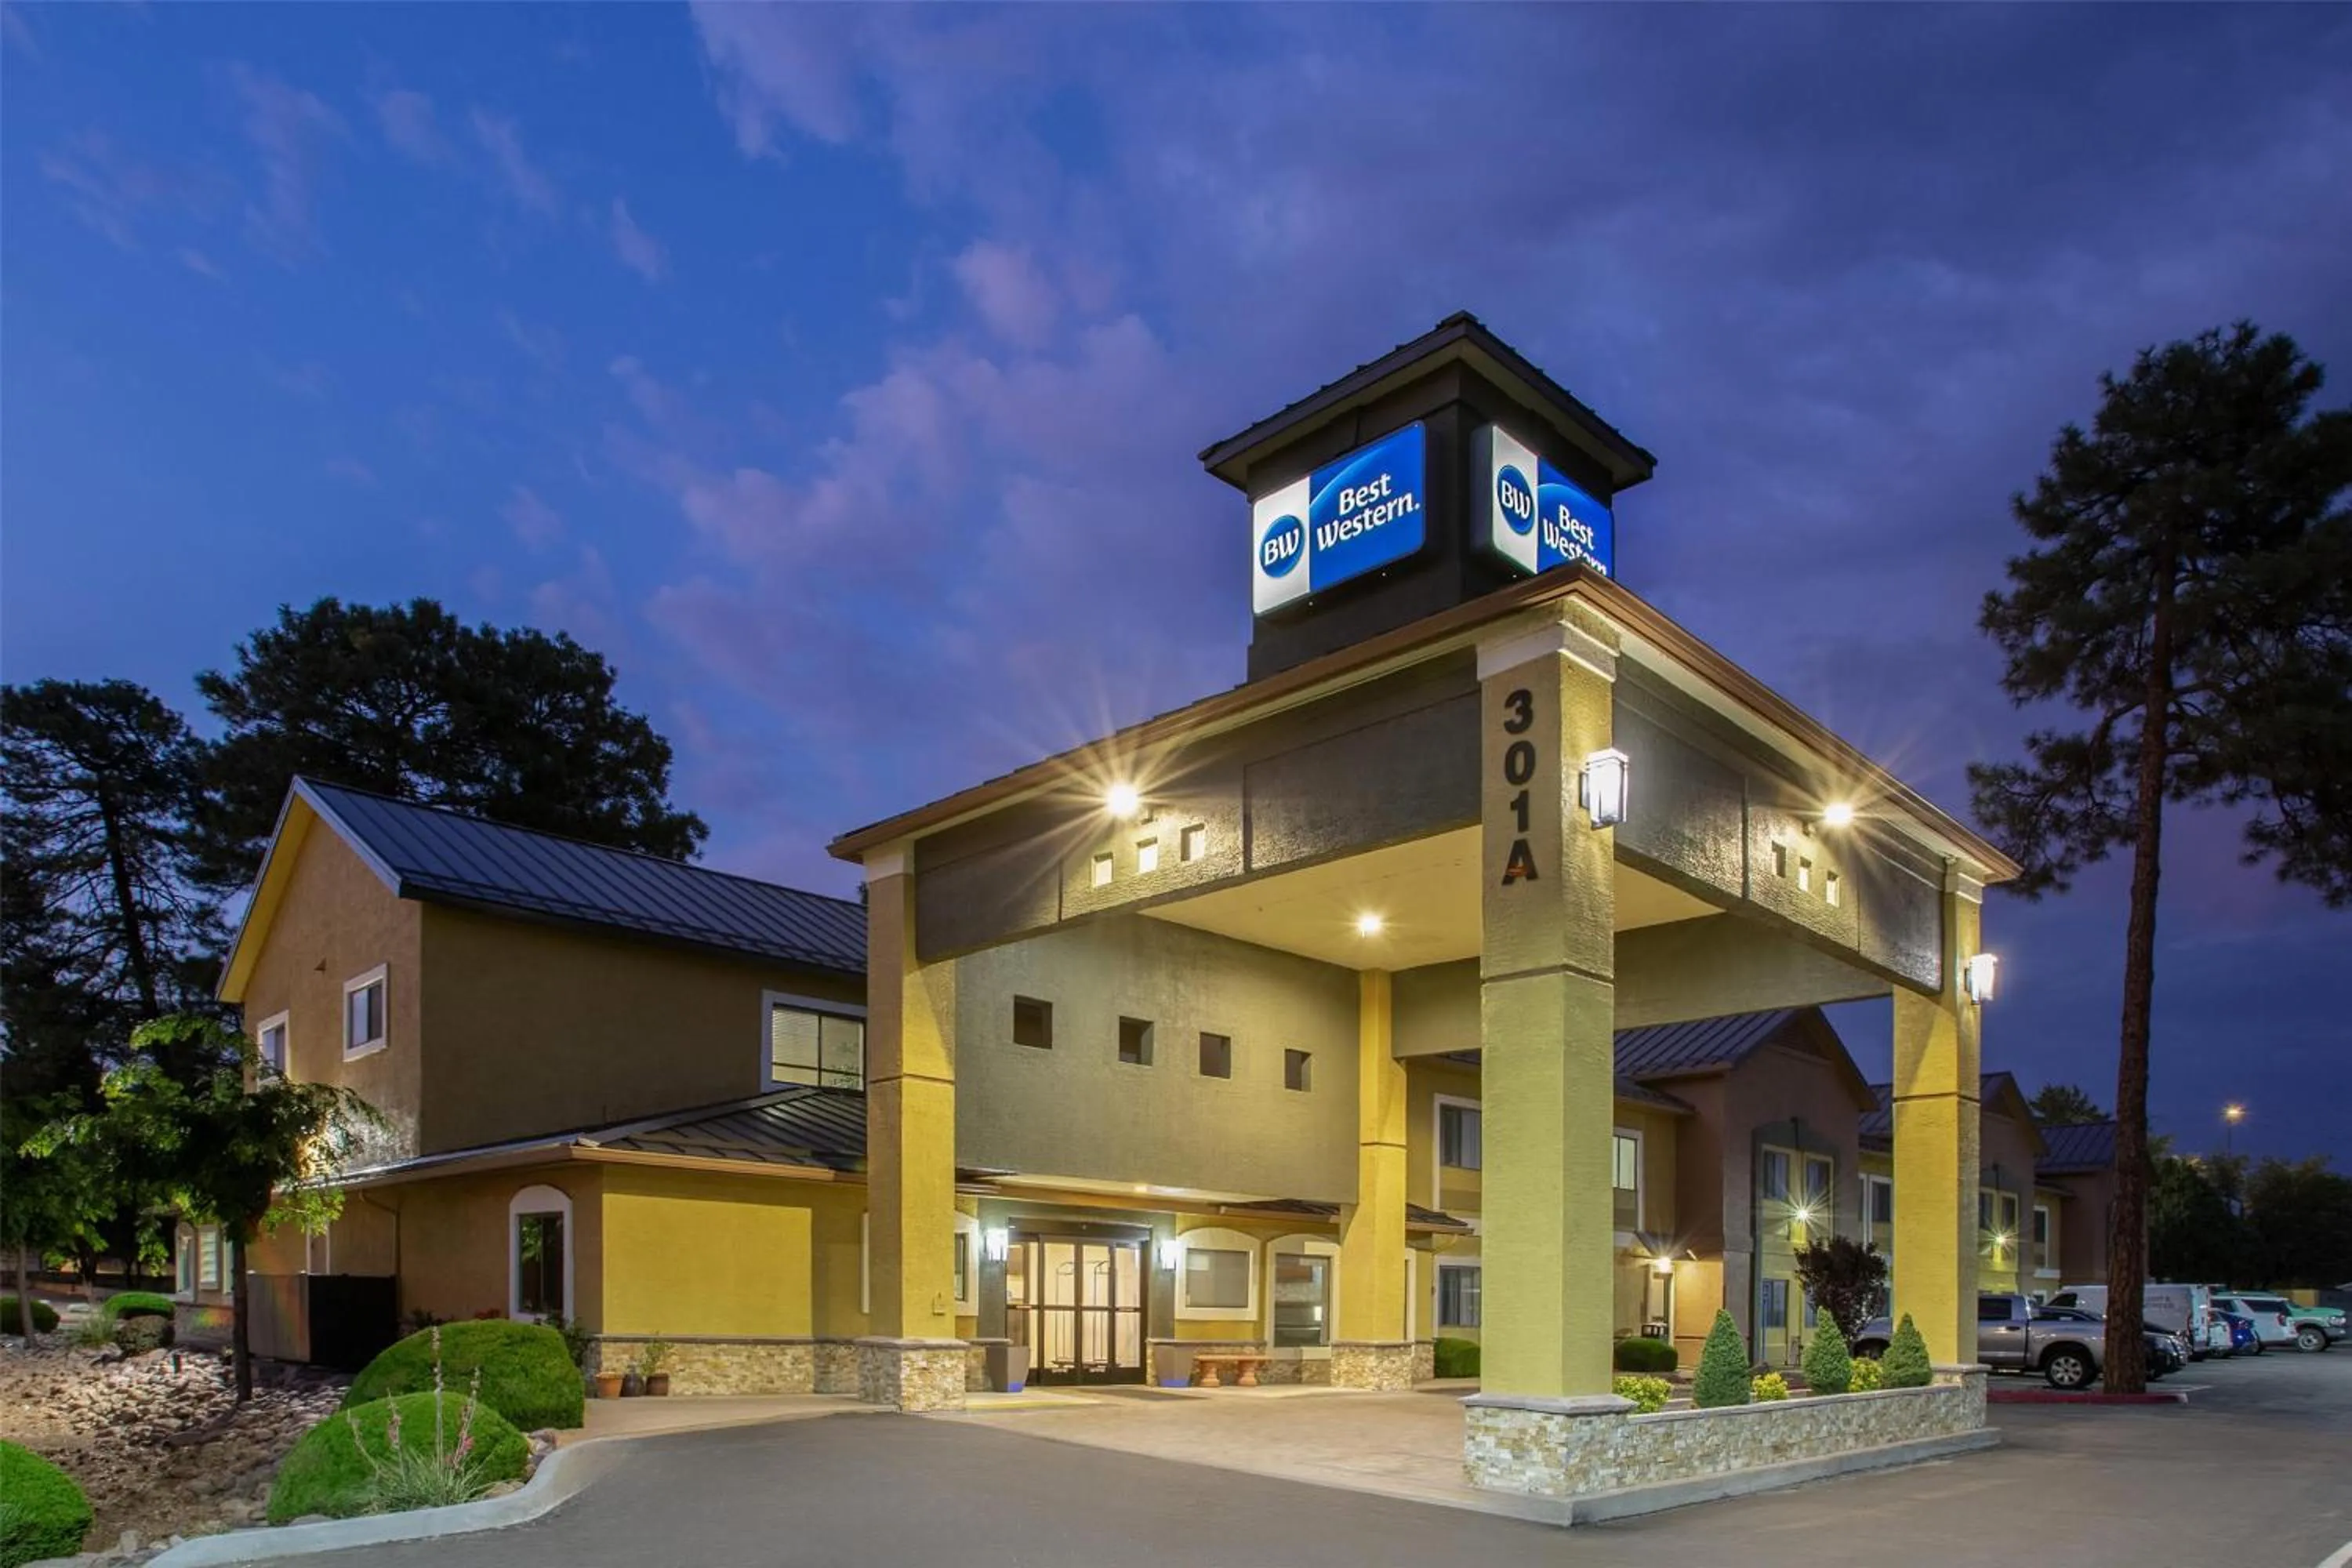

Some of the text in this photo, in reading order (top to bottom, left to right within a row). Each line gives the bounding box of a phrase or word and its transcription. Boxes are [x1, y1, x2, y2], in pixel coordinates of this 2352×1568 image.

[1339, 473, 1392, 516] Best
[1499, 480, 1530, 519] BW
[1264, 528, 1299, 566] BW
[1559, 504, 1595, 550] Best
[1501, 688, 1538, 886] 301A
